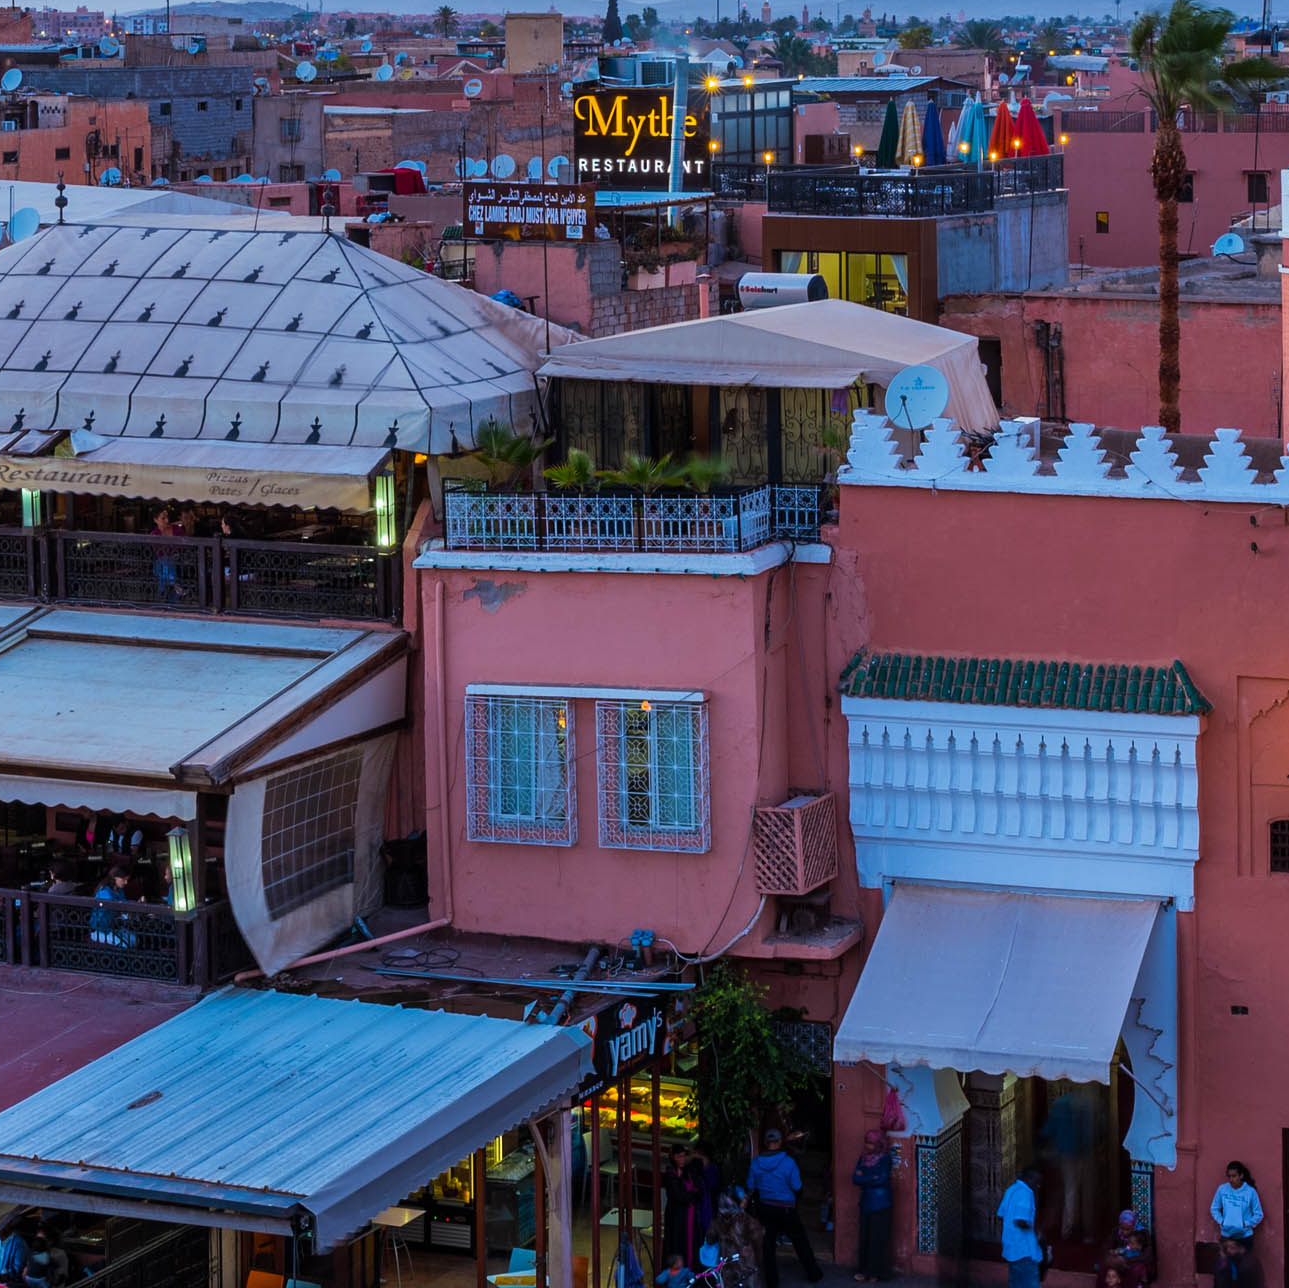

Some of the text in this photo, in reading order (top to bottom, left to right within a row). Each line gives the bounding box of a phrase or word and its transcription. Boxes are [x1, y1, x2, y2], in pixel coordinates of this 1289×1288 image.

[574, 95, 697, 156] Mythe
[578, 158, 704, 173] RESTAURNT
[469, 205, 484, 222] CHEZ
[485, 205, 508, 223] LAMINE
[509, 206, 525, 223] HADJ
[206, 472, 249, 484] Pizzas
[260, 483, 301, 496] Glaces
